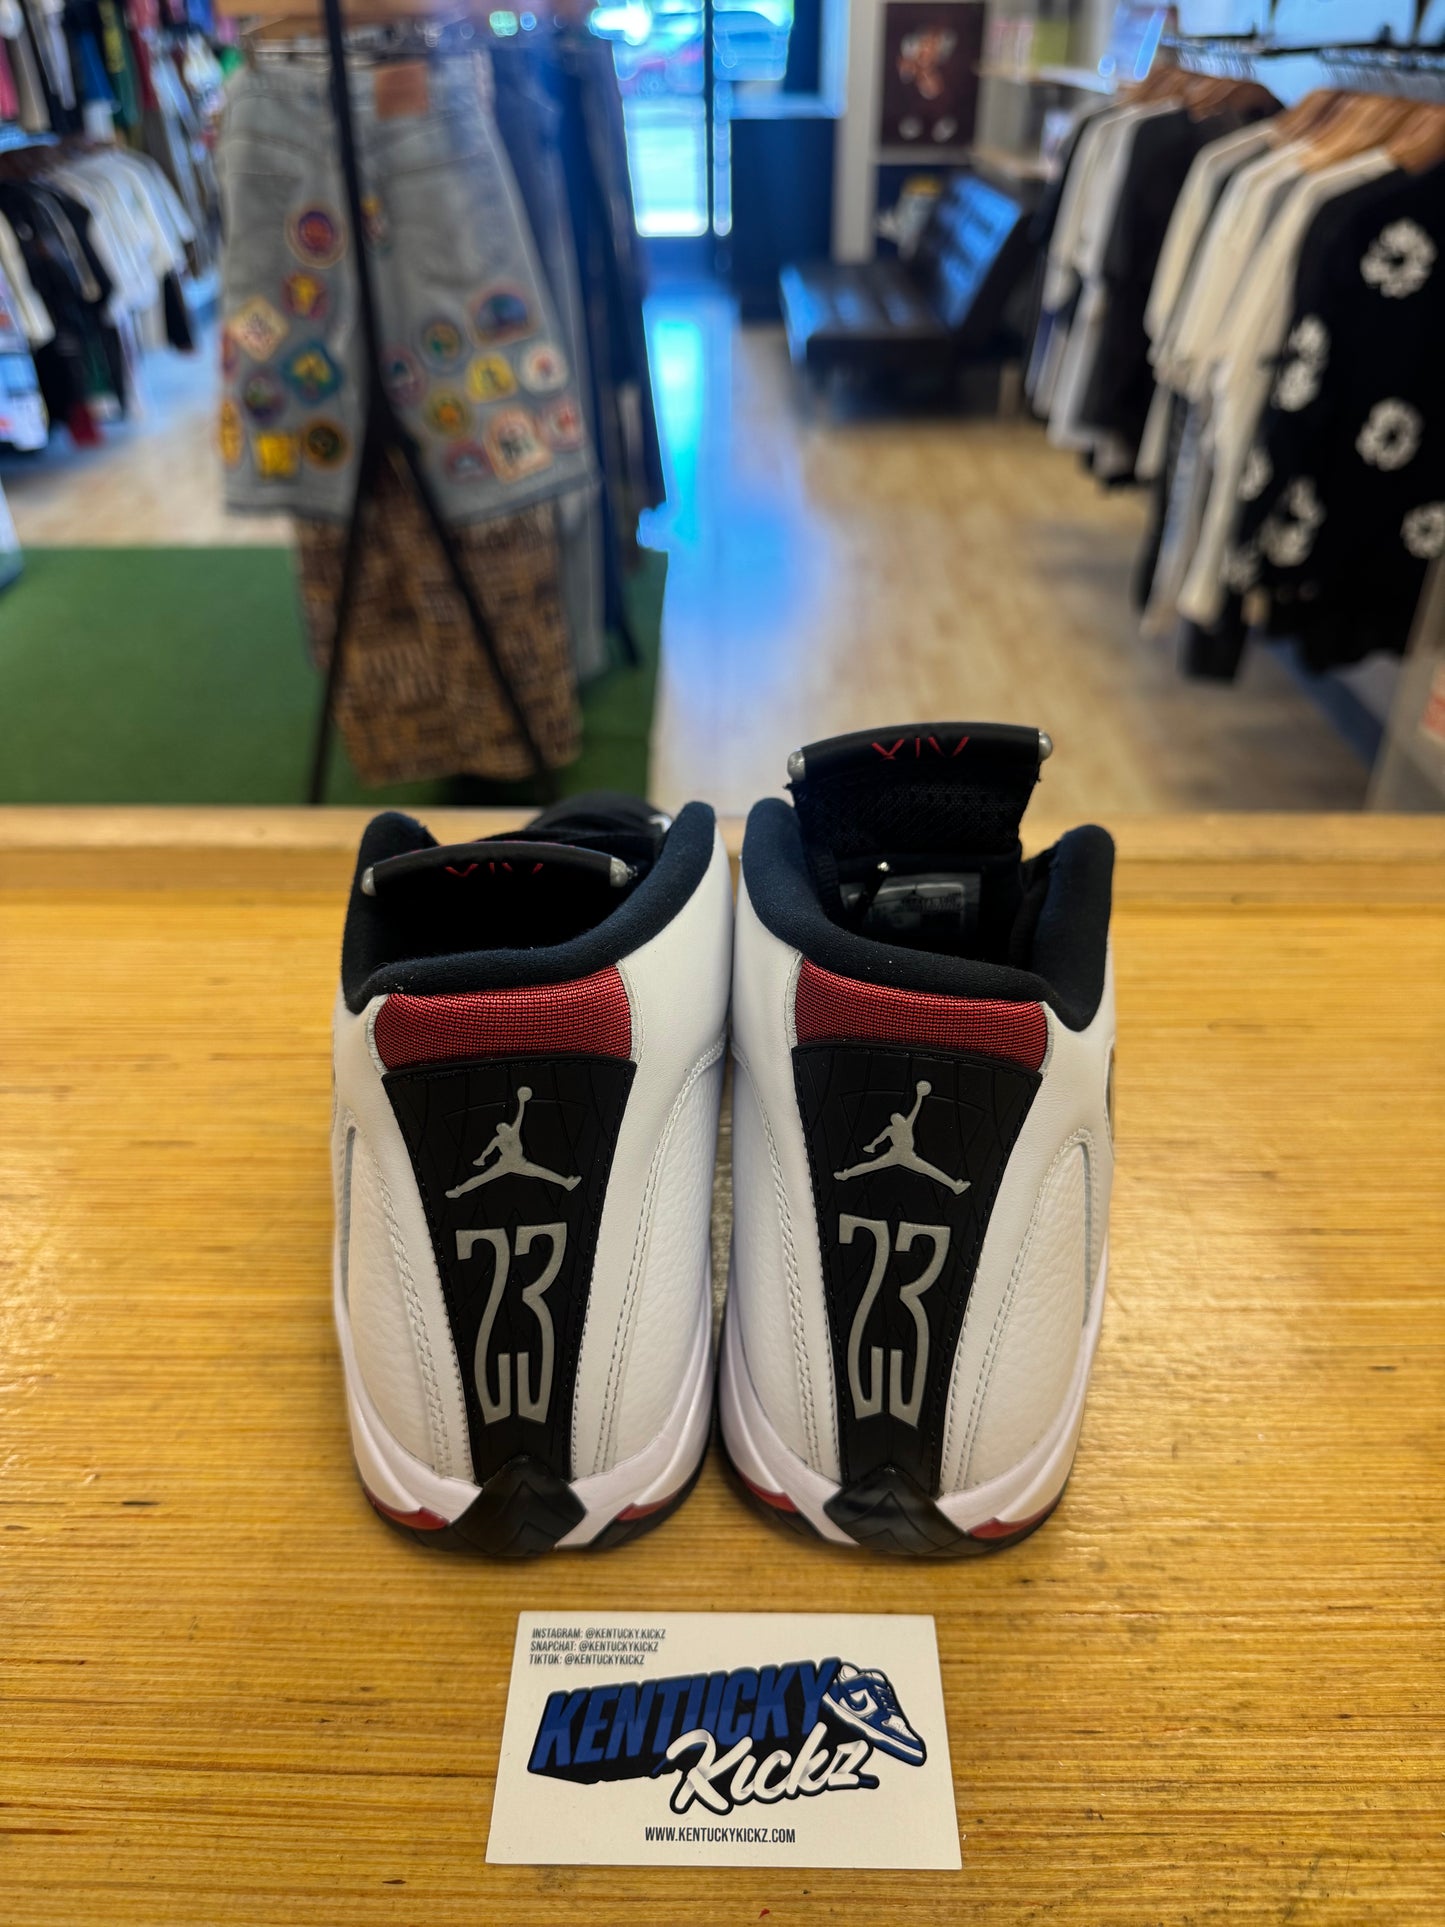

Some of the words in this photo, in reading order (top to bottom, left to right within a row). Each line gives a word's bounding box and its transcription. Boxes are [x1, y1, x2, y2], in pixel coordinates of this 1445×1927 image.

[455, 1221, 567, 1426] 23
[838, 1213, 951, 1428] 23
[529, 1653, 562, 1665] TIKTOK:
[564, 1653, 645, 1665] @KENTUCKYKICKZ
[530, 1640, 577, 1652] SNAPCHAT:
[579, 1641, 659, 1652] @KENTUCKYKICKZ
[532, 1627, 583, 1639] INSTAGRAM:
[530, 1659, 842, 1772] KENTUCKY
[666, 1721, 869, 1812] Kickz
[644, 1826, 796, 1843] WWW.KENTUCKYKICKZ.COM
